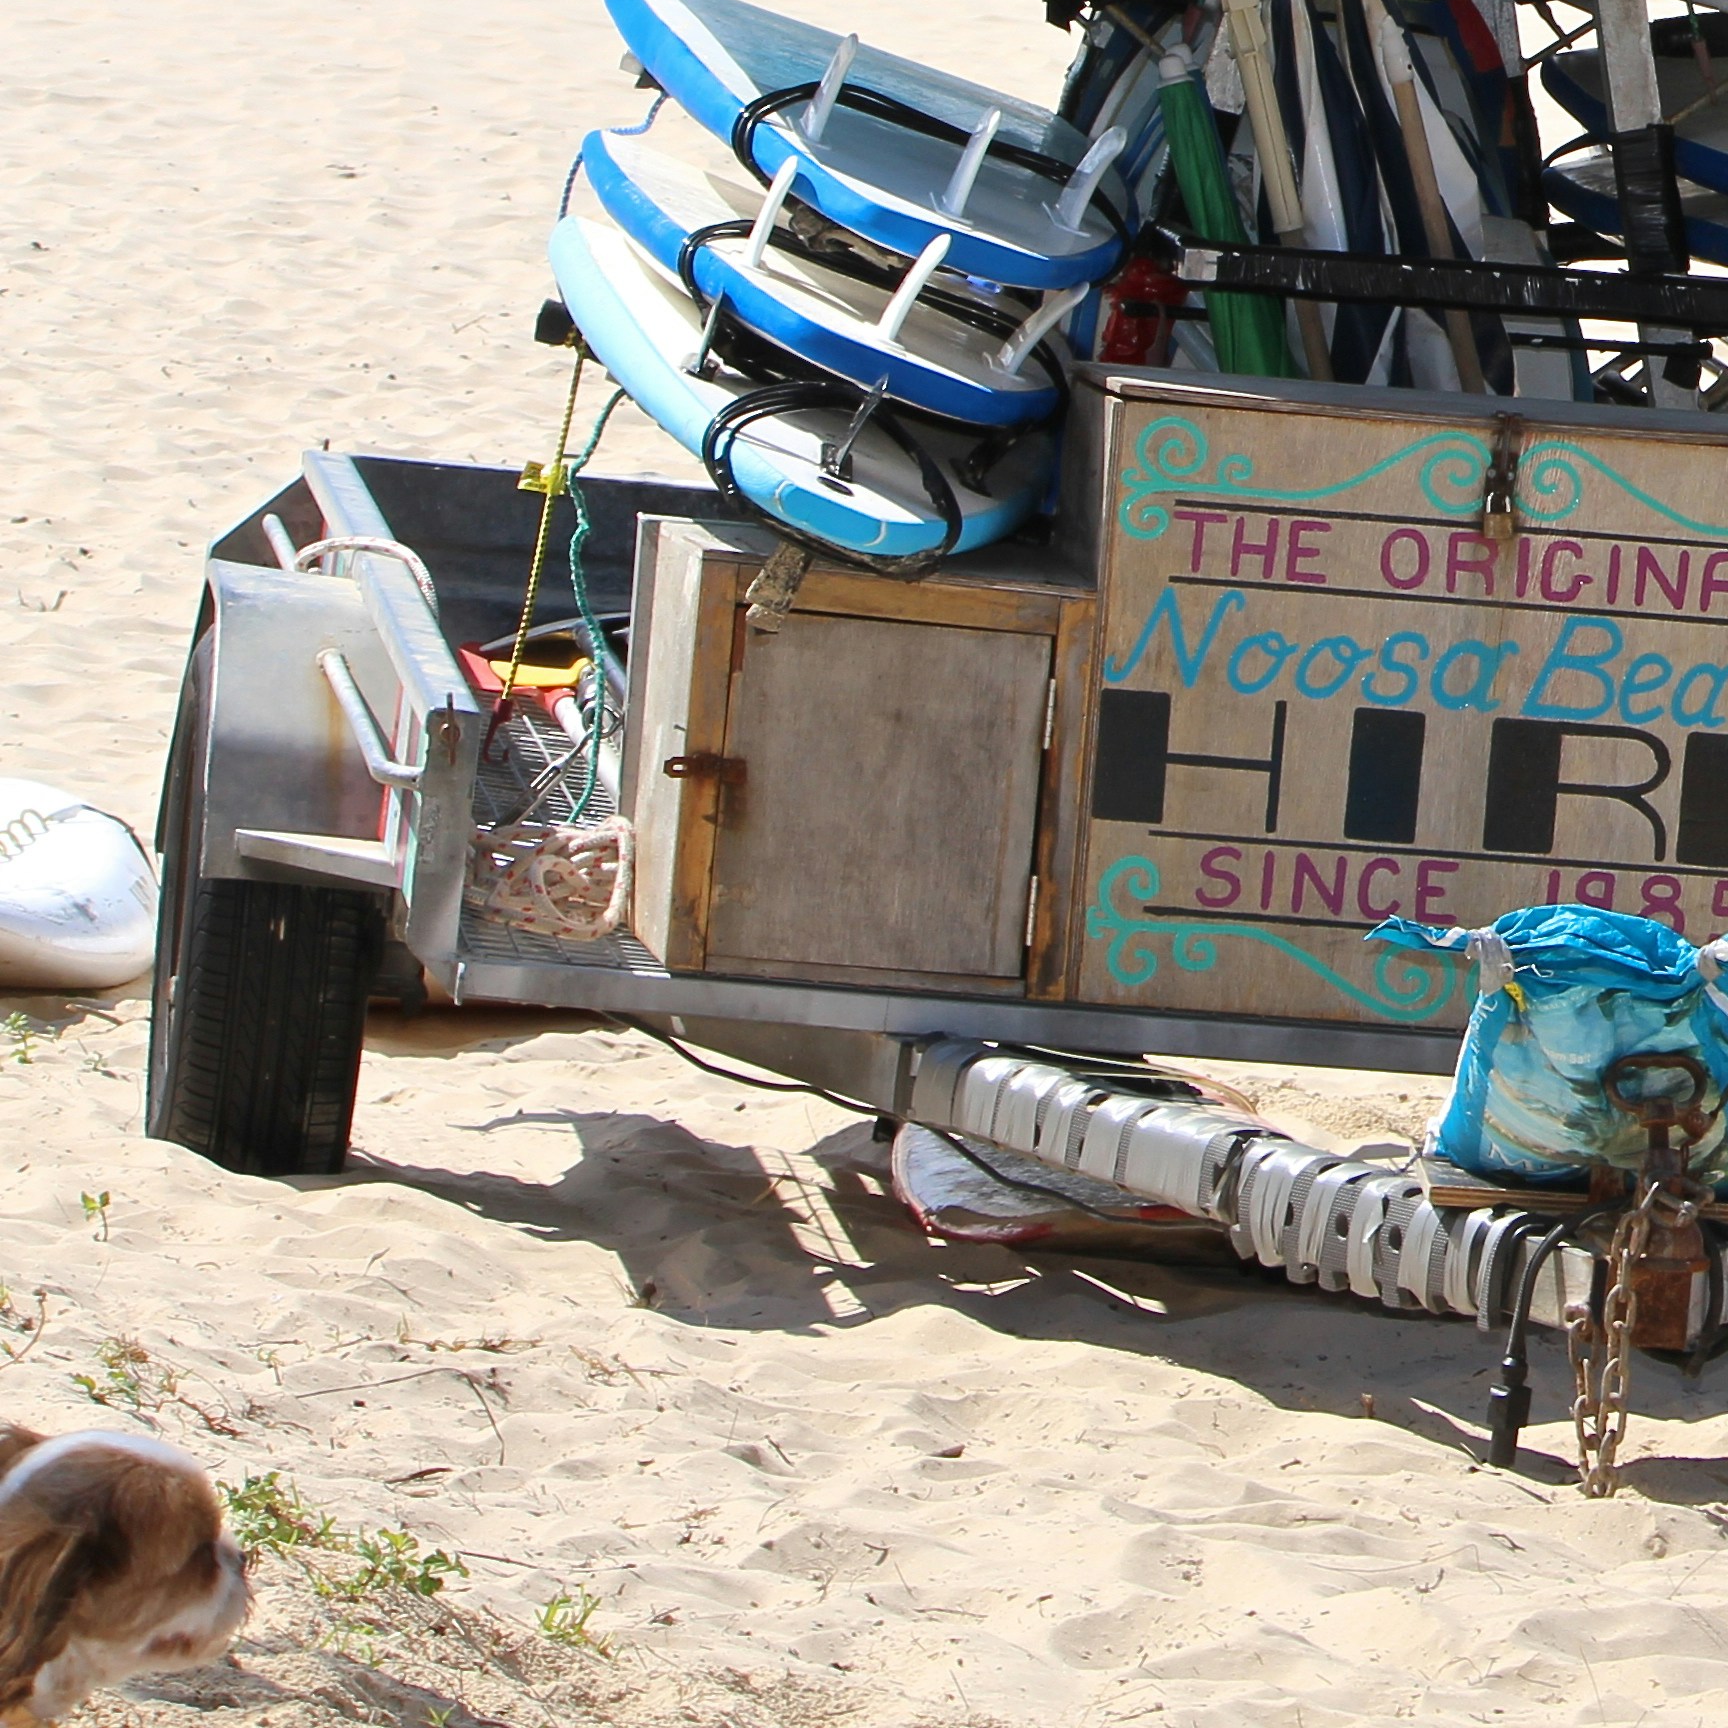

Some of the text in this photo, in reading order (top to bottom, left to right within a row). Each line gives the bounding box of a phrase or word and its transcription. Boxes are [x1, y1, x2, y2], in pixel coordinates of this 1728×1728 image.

[1174, 511, 1329, 585] THE
[1103, 587, 1519, 713] Noosa
[1195, 845, 1460, 924] SINCE
